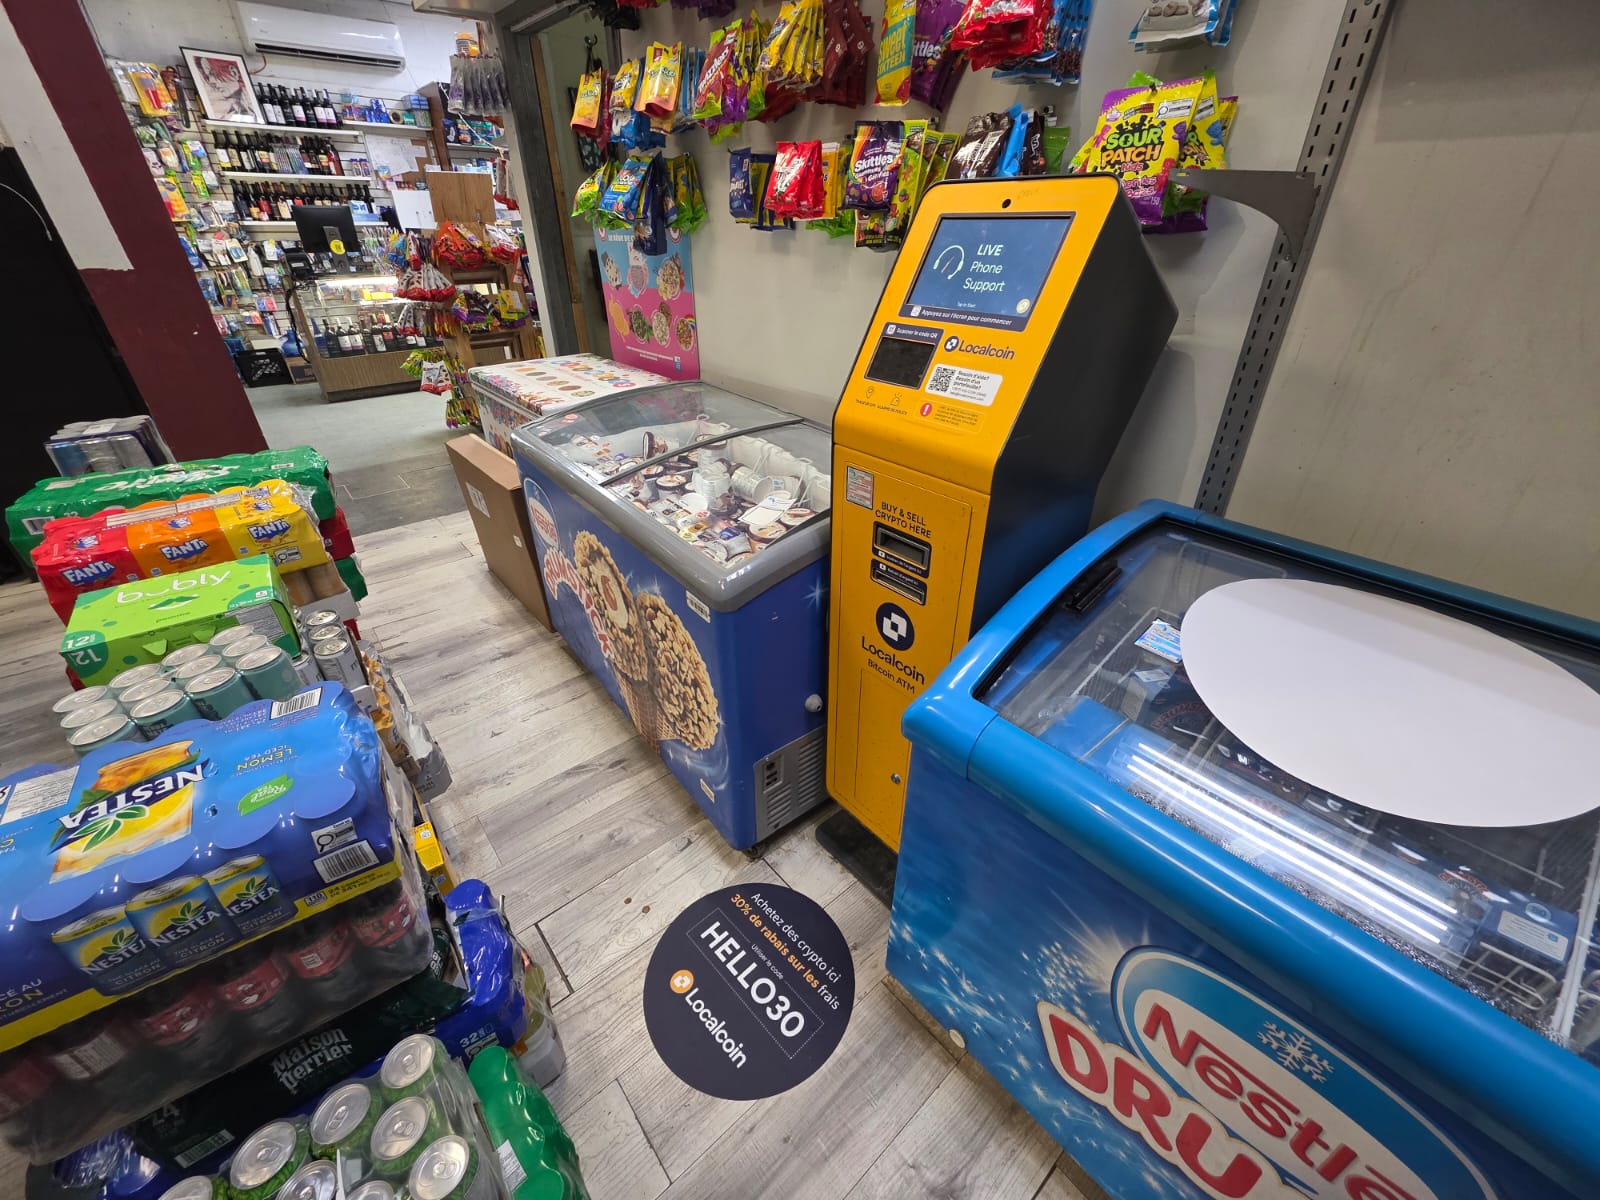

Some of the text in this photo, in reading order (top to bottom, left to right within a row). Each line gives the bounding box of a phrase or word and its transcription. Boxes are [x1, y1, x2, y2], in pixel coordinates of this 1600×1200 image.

[912, 41, 942, 60] ittles
[1105, 127, 1164, 150] SOUR
[854, 154, 894, 173] Skittles
[1101, 144, 1162, 168] PATCH
[977, 244, 1004, 256] LIVE
[970, 261, 1003, 274] Phone
[963, 277, 1006, 293] Support
[921, 309, 942, 318] Appuyez
[967, 315, 980, 323] pour
[980, 316, 1012, 326] commencer
[959, 340, 1015, 361] Localcoin
[875, 509, 932, 539] CRYPTO HERE
[881, 501, 926, 526] BUY & SELL
[116, 570, 231, 605] bubly
[65, 634, 89, 650] 12
[73, 648, 103, 666] 12
[861, 635, 925, 685] Localcoin
[867, 658, 915, 694] Bitcoin ATM
[237, 748, 294, 771] LEMON
[264, 744, 288, 755] ICED
[58, 764, 205, 829] NESTEA
[149, 909, 220, 948] NESTEA
[751, 893, 842, 984] Achetez des crypto ici
[180, 936, 226, 959] CITRON
[731, 893, 840, 1010] 30% de rabais sur les frais
[751, 943, 784, 980] Utiliser le code
[22, 978, 42, 992] AU
[115, 961, 161, 986] CITRON
[700, 921, 805, 1038] HELLO30
[459, 1031, 479, 1048] 32
[684, 987, 747, 1069] Localcoin
[271, 1028, 349, 1078] Maison
